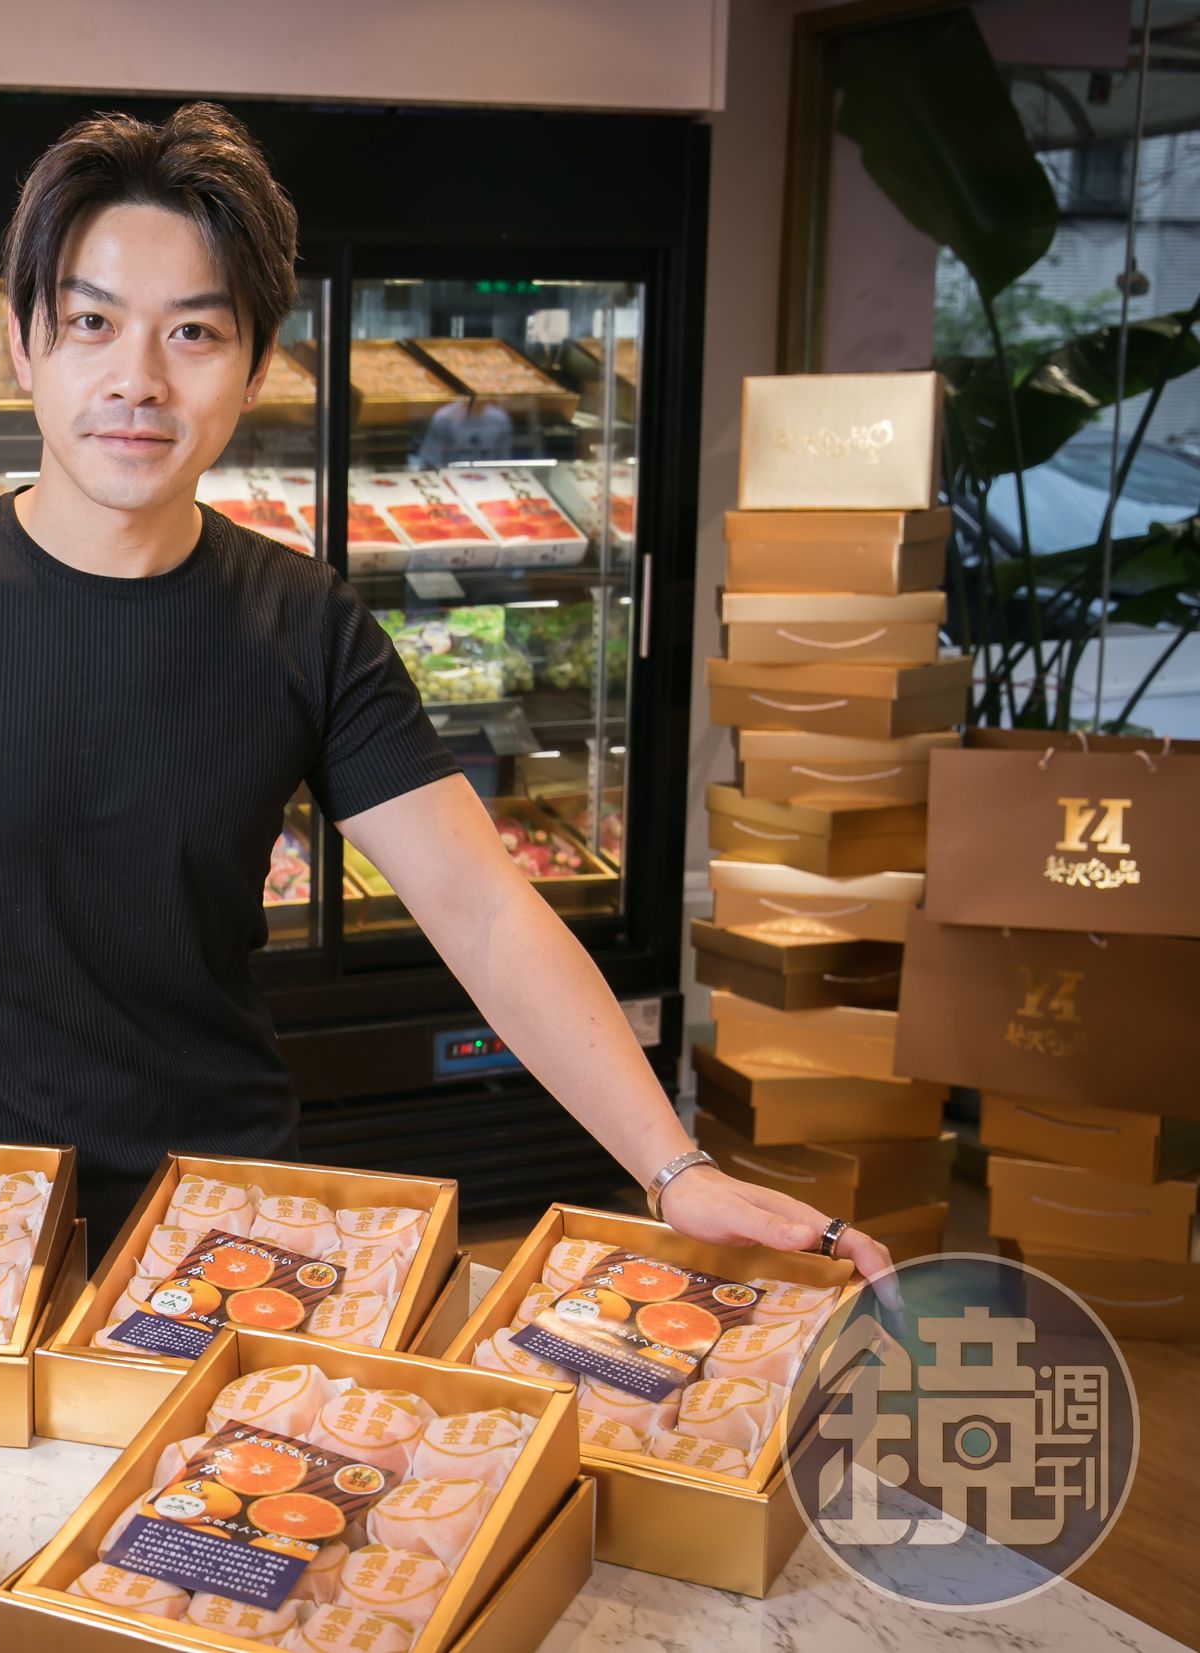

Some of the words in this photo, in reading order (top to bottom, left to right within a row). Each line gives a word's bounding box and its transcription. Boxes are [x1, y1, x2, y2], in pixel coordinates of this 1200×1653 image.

[215, 1238, 293, 1265] 日本の美味しい
[176, 1252, 215, 1287] みかん
[582, 1264, 625, 1298] みかん
[607, 1327, 699, 1365] 切な人への贈り物
[232, 1430, 328, 1467] 日本の美味しい
[185, 1448, 235, 1492] みかん
[93, 1577, 153, 1599] 金賞
[203, 1607, 265, 1631] 金賞
